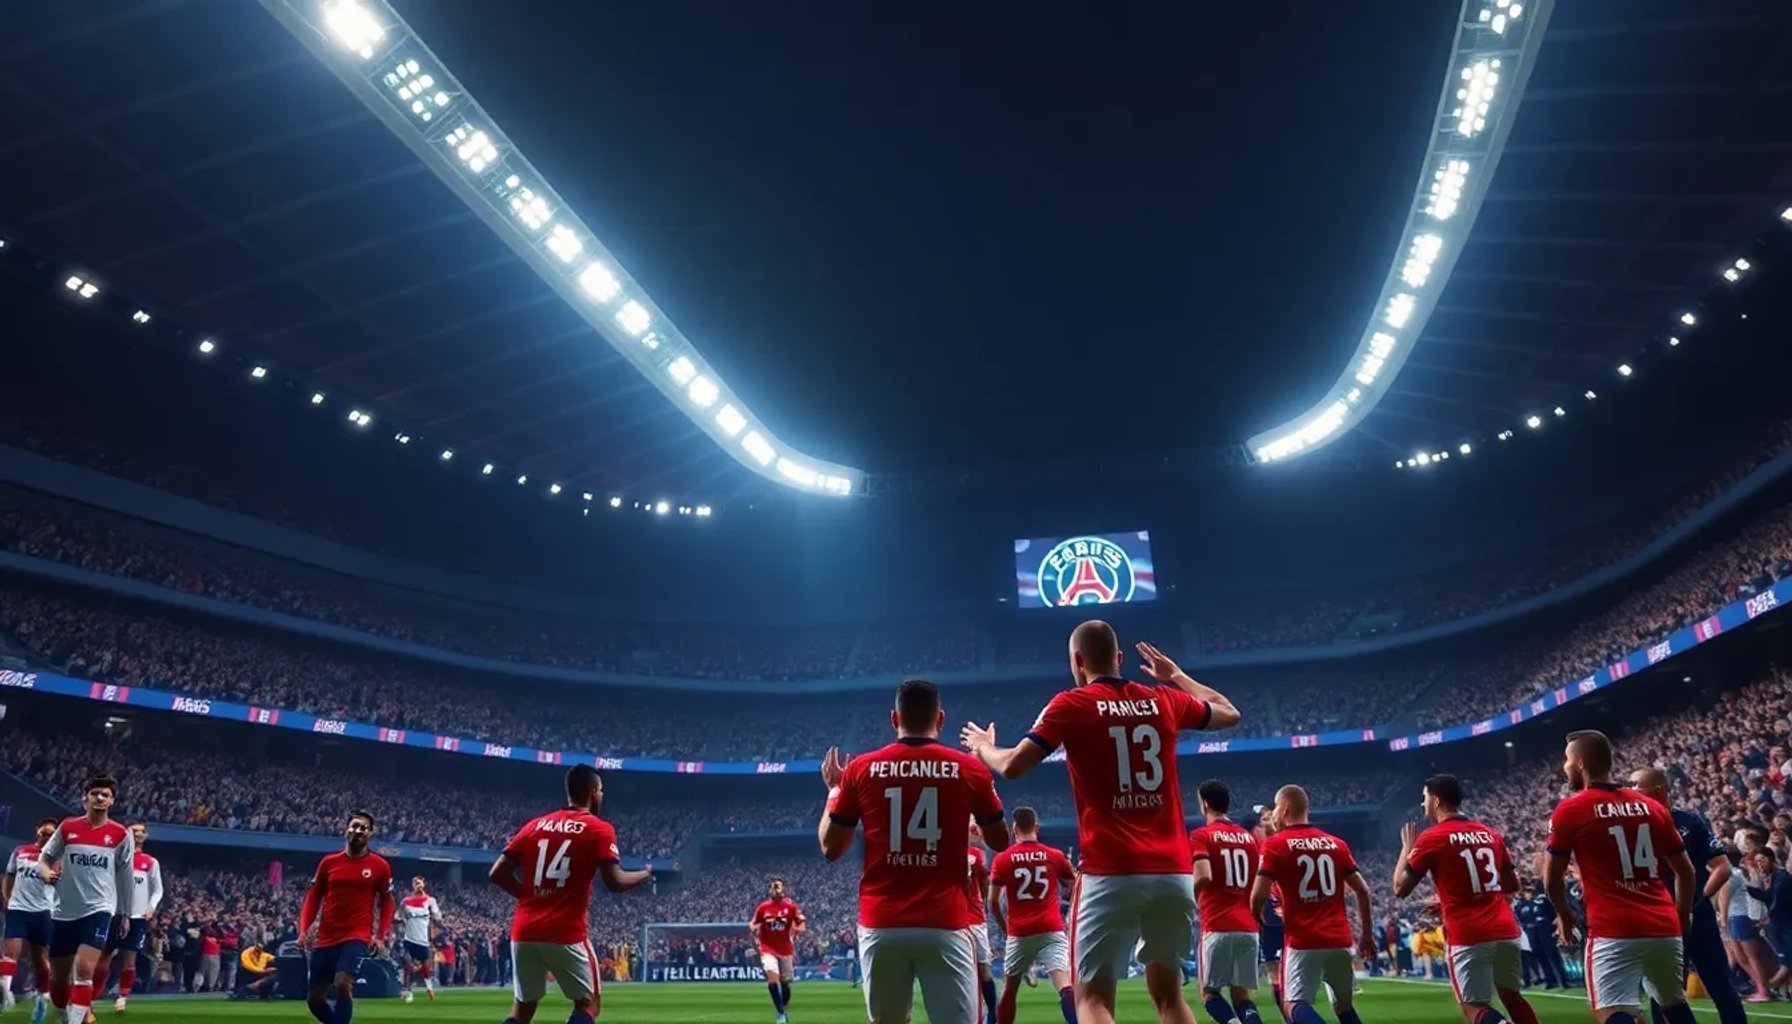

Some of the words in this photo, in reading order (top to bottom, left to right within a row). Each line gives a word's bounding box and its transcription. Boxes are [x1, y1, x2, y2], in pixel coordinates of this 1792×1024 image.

[1108, 724, 1163, 793] 13
[884, 786, 942, 852] 14
[534, 838, 572, 888] 14
[1220, 848, 1249, 888] 10
[1459, 847, 1502, 894] 13
[1608, 822, 1658, 878] 14
[1014, 865, 1049, 900] 25
[1297, 853, 1337, 899] 20
